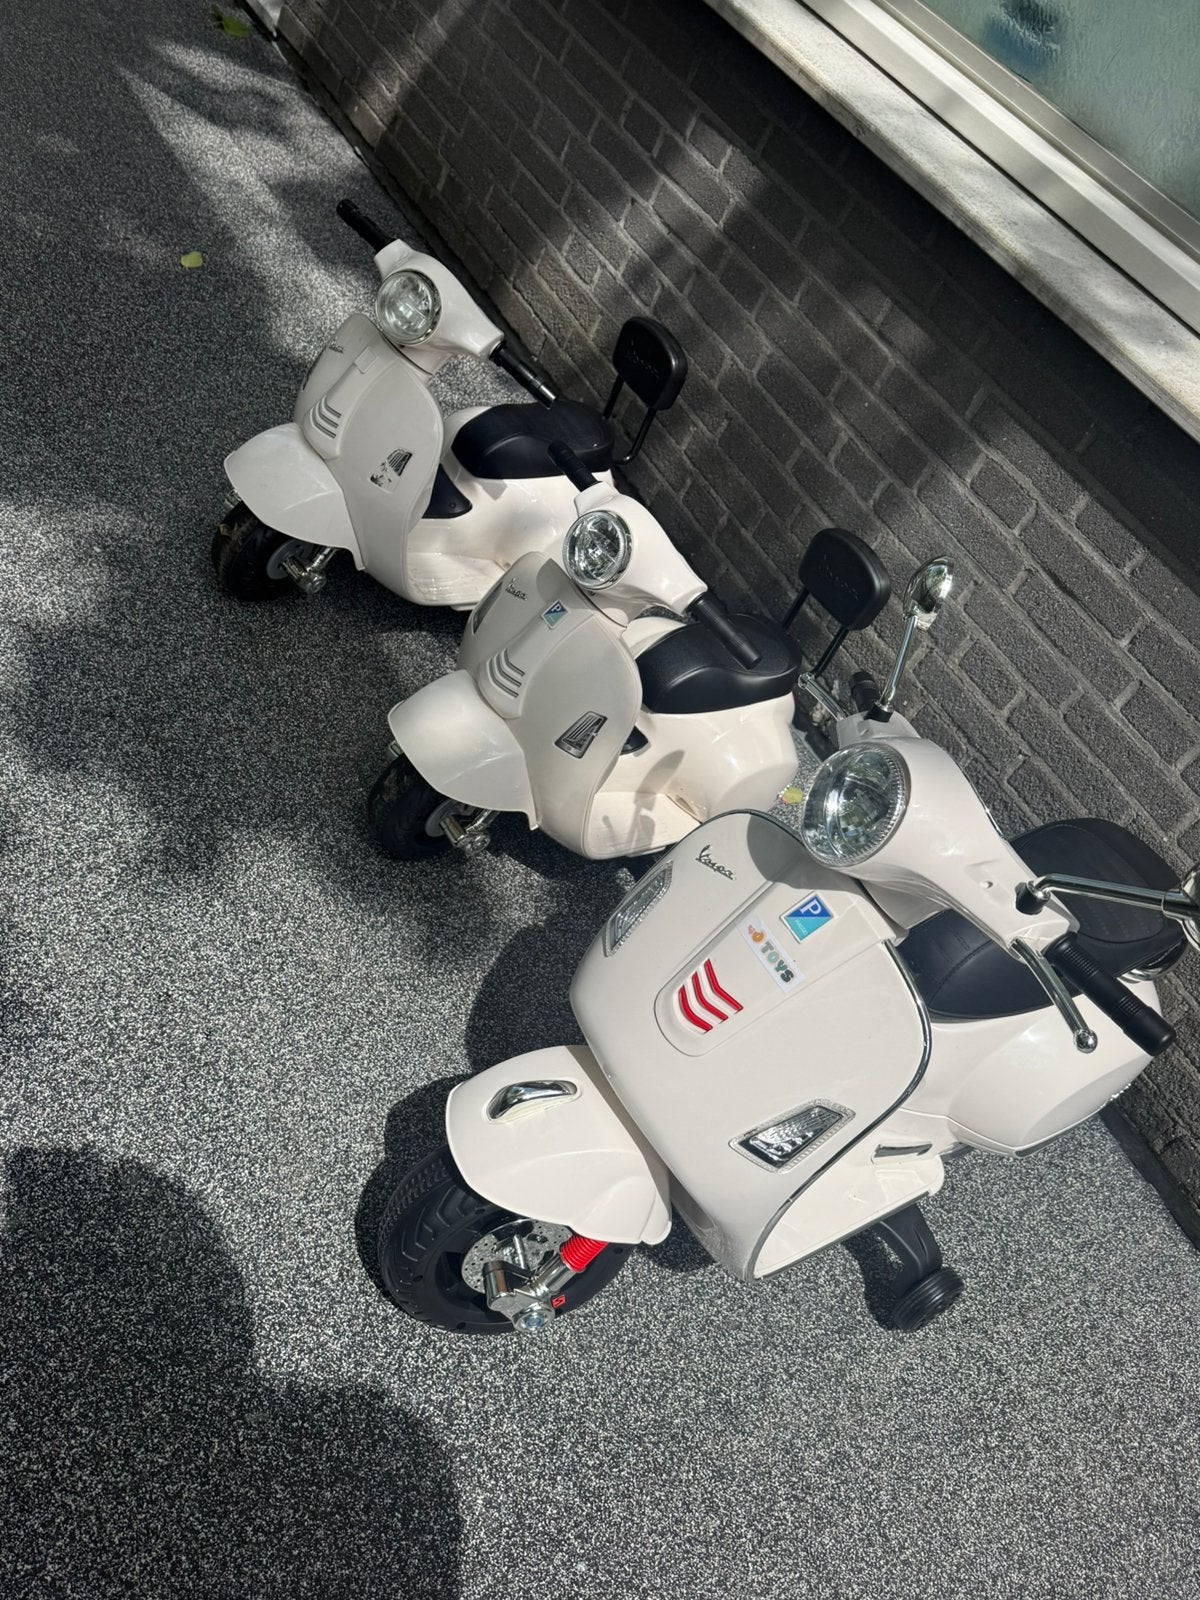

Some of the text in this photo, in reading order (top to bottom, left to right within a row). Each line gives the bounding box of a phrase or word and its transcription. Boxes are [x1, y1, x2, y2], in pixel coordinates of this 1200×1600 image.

[551, 603, 562, 612] P
[695, 844, 736, 880] Vespa
[800, 899, 822, 915] P
[761, 941, 794, 982] TOYS
